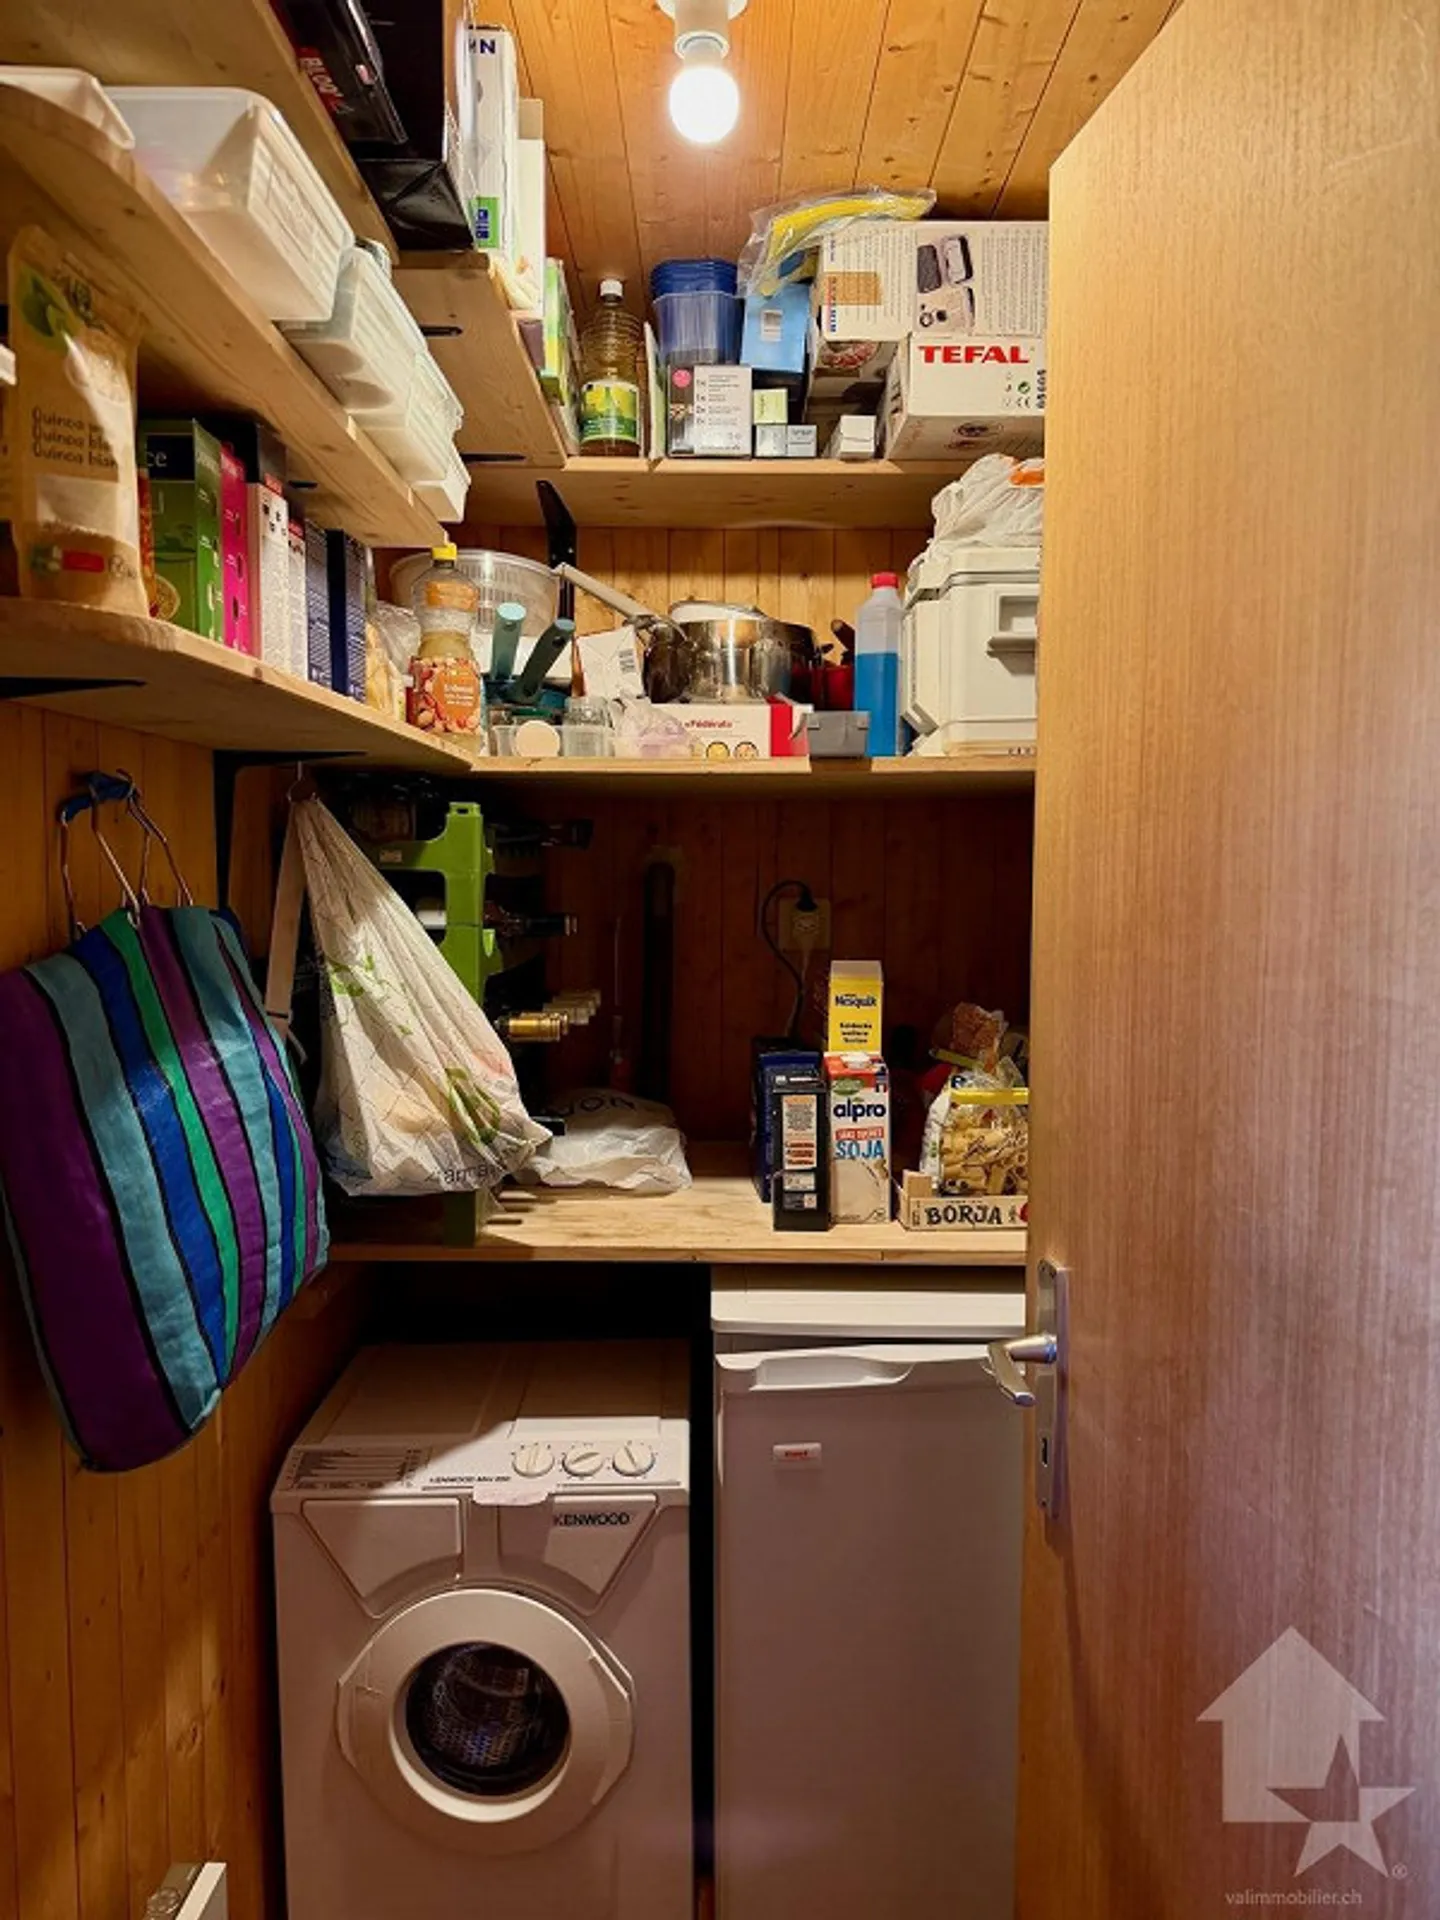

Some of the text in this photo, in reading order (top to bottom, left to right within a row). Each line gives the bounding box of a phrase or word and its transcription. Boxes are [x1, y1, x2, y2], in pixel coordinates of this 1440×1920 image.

[917, 345, 1030, 364] TEFAL
[32, 404, 85, 430] Quinoa
[32, 424, 85, 447] Quinoa
[32, 442, 84, 465] Quinoa
[833, 1098, 886, 1122] alpro
[835, 1139, 885, 1159] SOJA
[924, 1205, 1002, 1226] BORJA
[553, 1512, 630, 1526] KENWOOD
